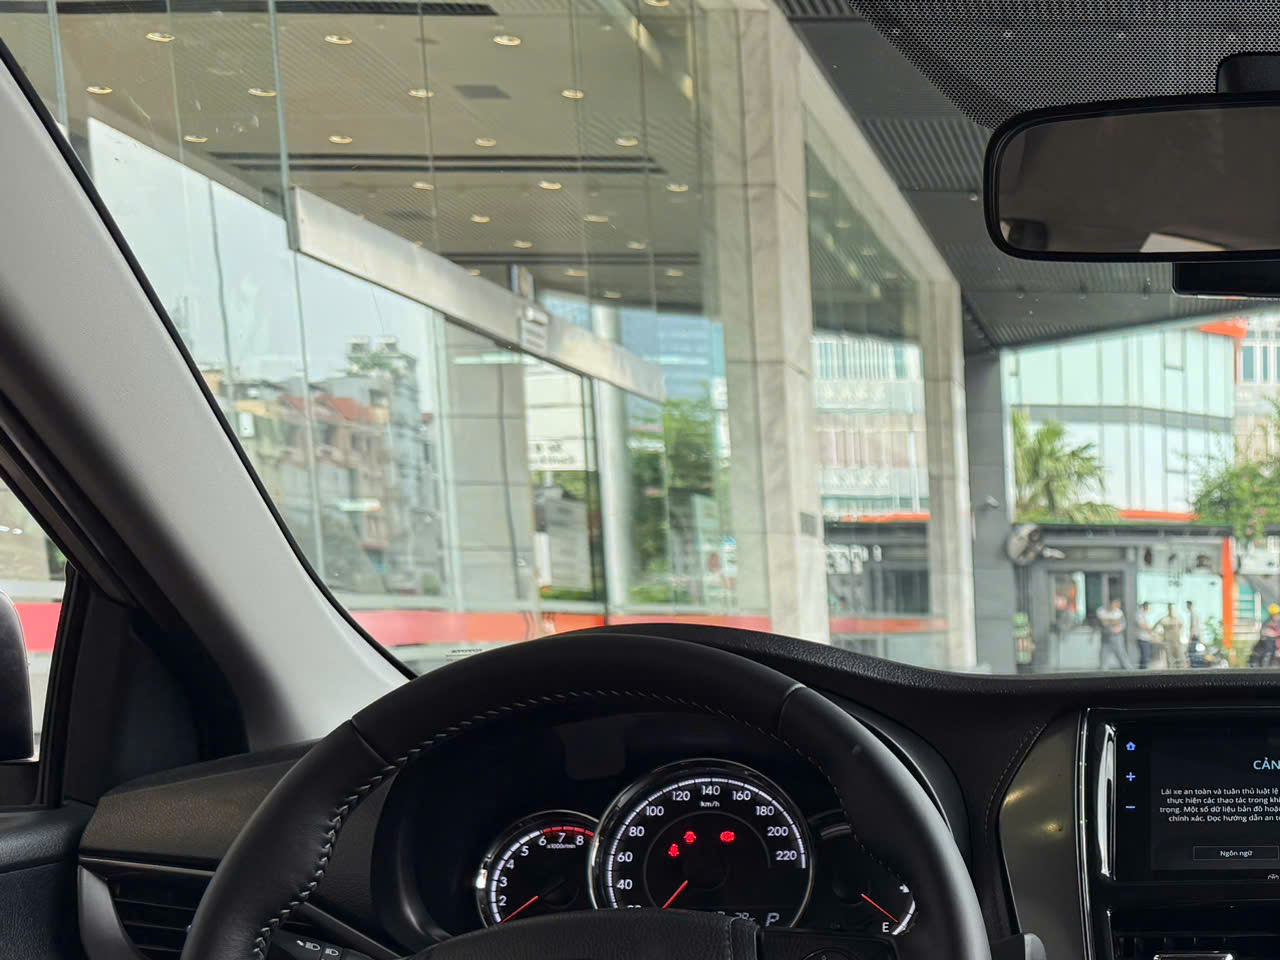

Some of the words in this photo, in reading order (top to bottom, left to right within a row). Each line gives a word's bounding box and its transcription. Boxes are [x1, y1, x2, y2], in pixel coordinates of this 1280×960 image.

[671, 790, 690, 802] 120
[701, 784, 720, 796] 140
[732, 790, 752, 801] 160
[1256, 787, 1271, 796] luật
[1271, 787, 1279, 796] lệ
[700, 800, 720, 808] km/h
[1166, 796, 1184, 806] thực
[1185, 796, 1202, 806] hiện
[1248, 796, 1268, 805] trong
[646, 804, 664, 816] 100
[756, 804, 775, 816] 180
[1159, 805, 1182, 814] trọng.
[1183, 805, 1199, 814] Một
[1199, 804, 1209, 812] số
[1222, 805, 1236, 814] liệu
[1253, 804, 1264, 812] đồ
[1206, 814, 1222, 823] Đọc
[1222, 814, 1248, 823] hướng
[1248, 813, 1263, 821] dẫn
[628, 825, 645, 838] 80
[767, 825, 788, 837] 200
[538, 834, 546, 846] 6
[558, 832, 566, 844] 7
[576, 834, 584, 846] 8
[521, 845, 530, 856] 5
[617, 850, 633, 863] 60
[776, 850, 798, 862] 220
[507, 859, 515, 870] 4
[500, 876, 508, 888] 3
[617, 878, 633, 890] 40
[499, 894, 507, 906] 2
[882, 922, 890, 932] E
